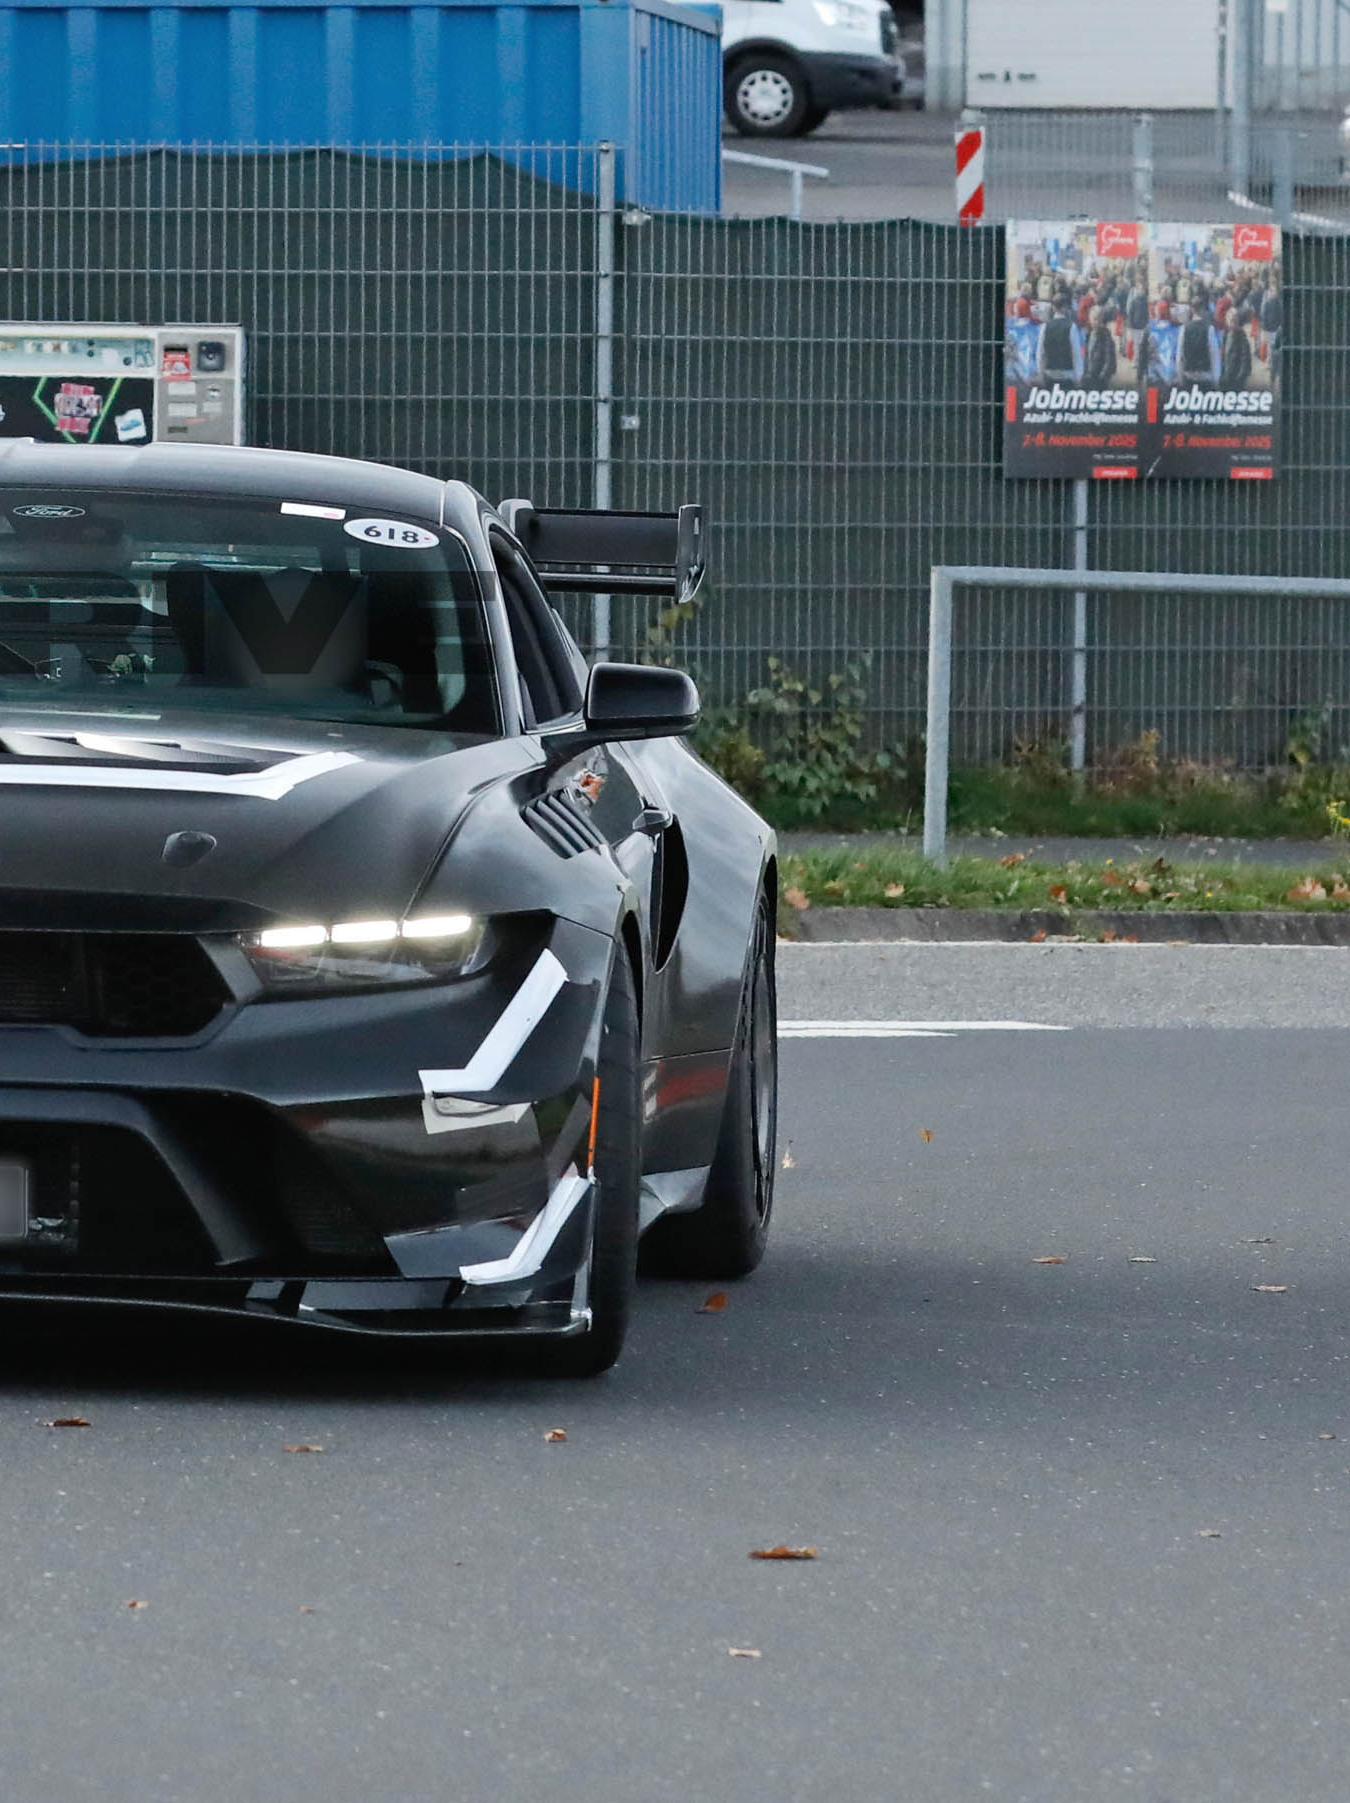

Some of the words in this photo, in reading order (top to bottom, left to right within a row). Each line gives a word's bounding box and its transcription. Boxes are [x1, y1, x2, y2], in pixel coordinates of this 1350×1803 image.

[1023, 384, 1139, 410] Jobmesse
[1163, 384, 1273, 411] Jobmesse
[1048, 433, 1105, 447] November
[1106, 433, 1138, 448] 2025
[1187, 434, 1242, 448] November
[25, 506, 73, 517] Ford
[364, 520, 419, 544] 618
